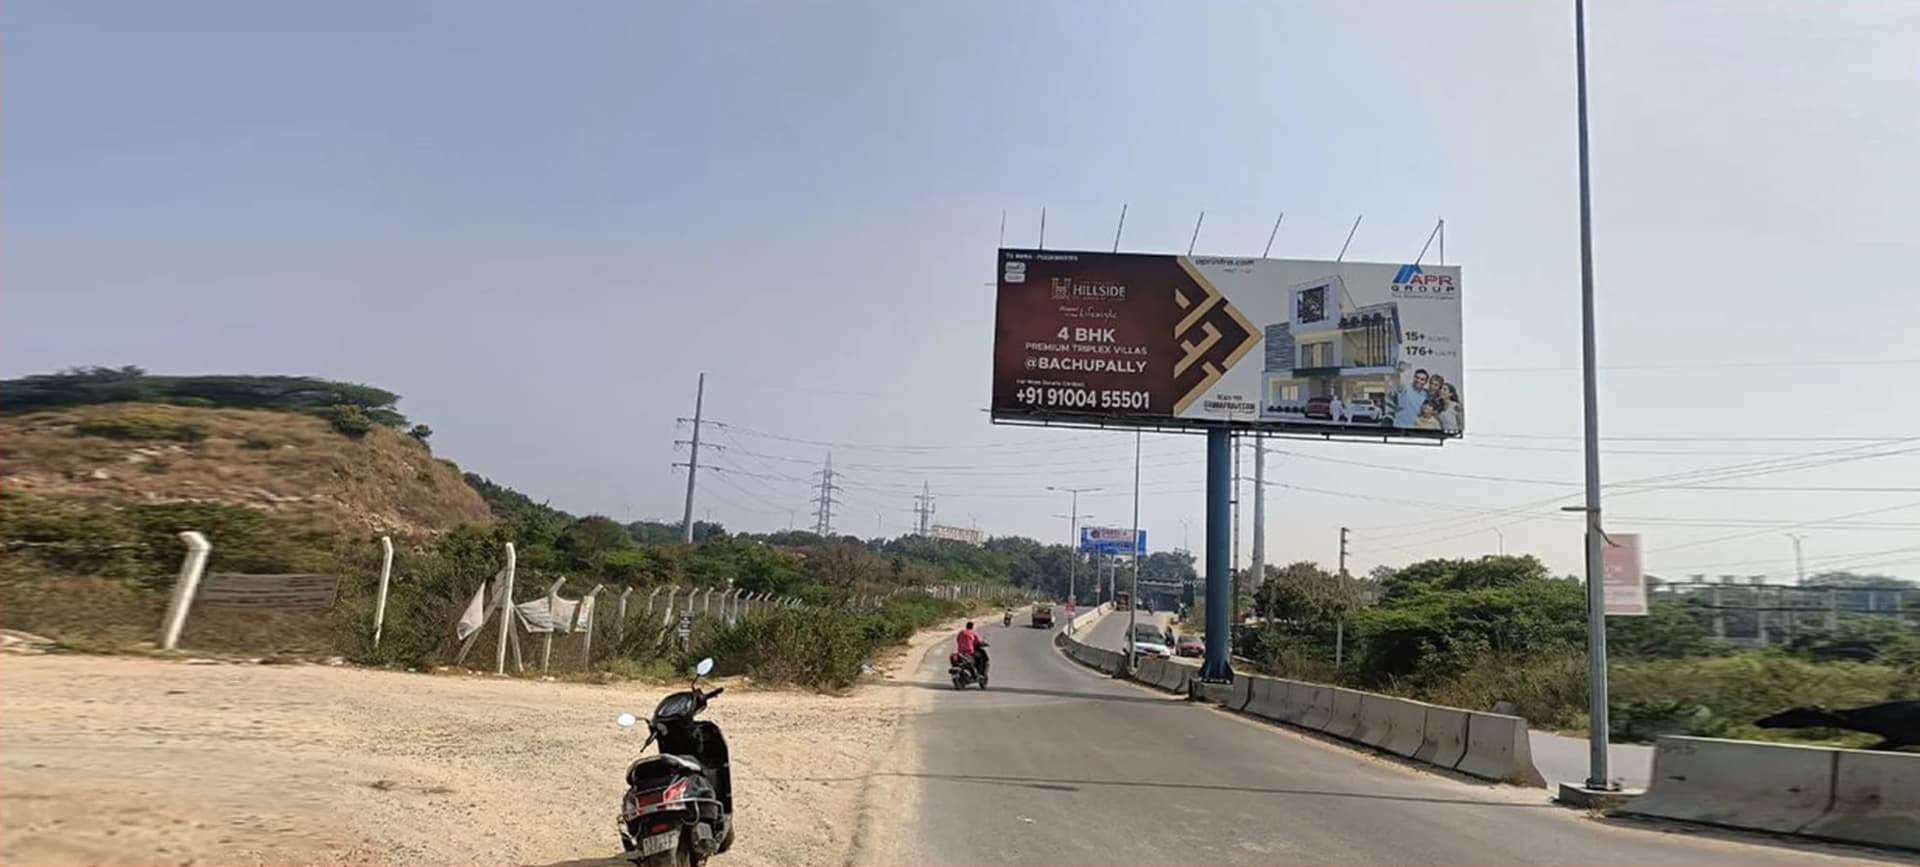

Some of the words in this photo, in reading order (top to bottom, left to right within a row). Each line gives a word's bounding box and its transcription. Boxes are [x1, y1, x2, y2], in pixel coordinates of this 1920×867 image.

[1410, 274, 1453, 286] APR
[1073, 283, 1128, 297] HILLSIDE
[1391, 285, 1455, 293] GROUP
[1057, 326, 1070, 341] 4
[1075, 327, 1116, 342] BHK
[1405, 331, 1425, 342] 15+
[1025, 342, 1070, 352] PREMIUM
[1072, 344, 1111, 354] TRIPLEX
[1113, 346, 1148, 355] VILLAS
[1406, 346, 1433, 357] 176+
[1024, 356, 1147, 374] @BACHUPALLY
[1016, 386, 1043, 405] +91
[1047, 388, 1097, 408] 91004
[1101, 390, 1150, 409] 55501
